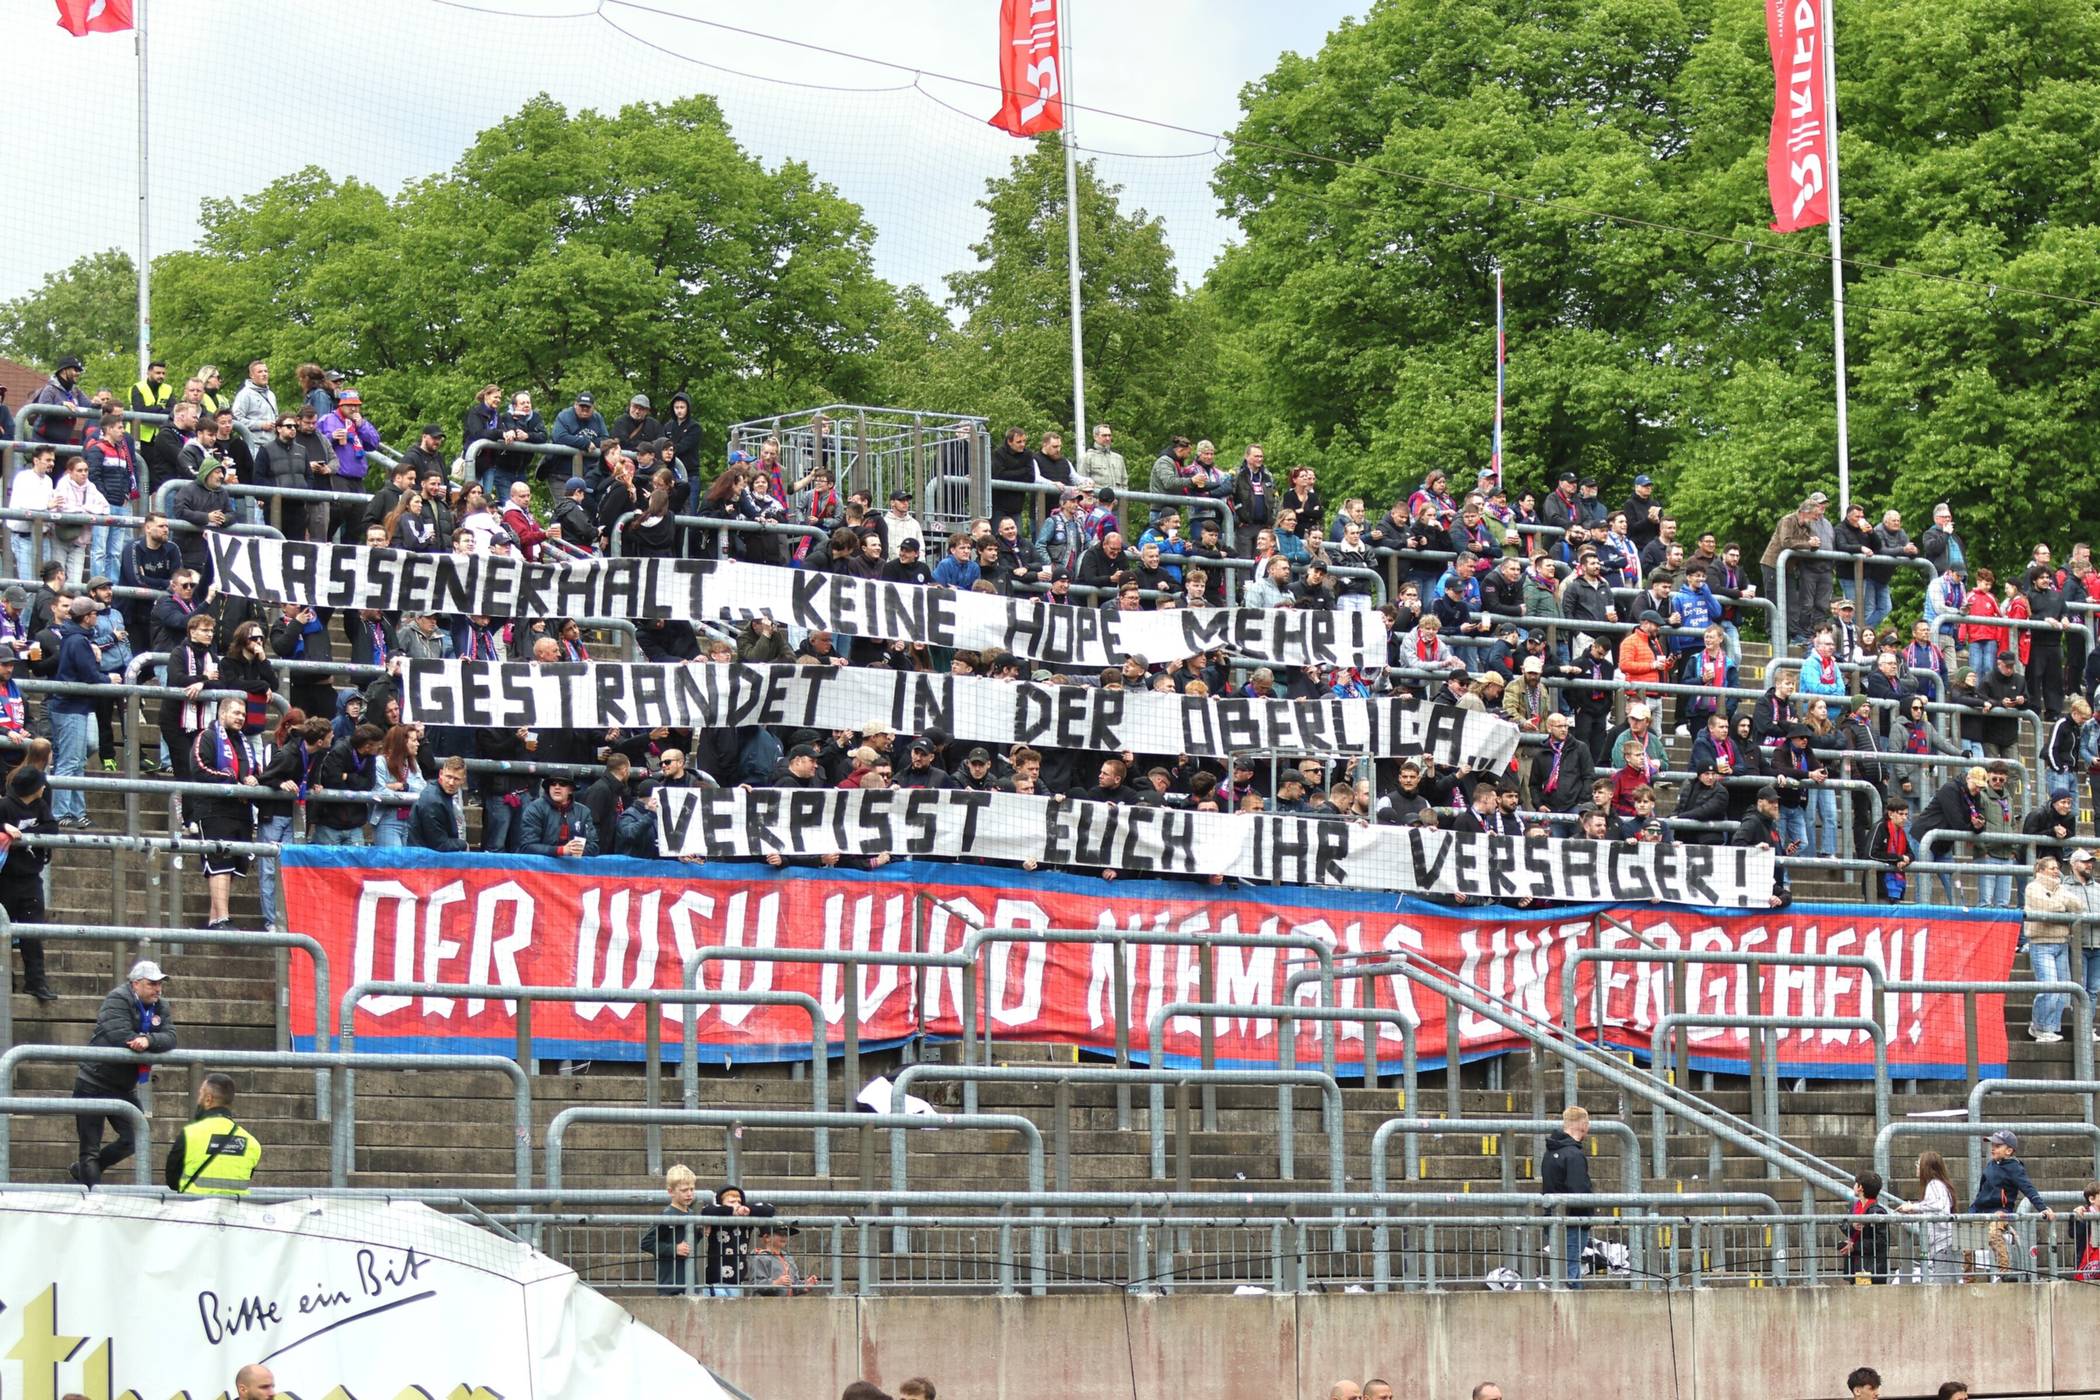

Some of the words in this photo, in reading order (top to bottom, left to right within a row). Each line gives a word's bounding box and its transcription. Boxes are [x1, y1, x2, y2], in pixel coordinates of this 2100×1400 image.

[792, 569, 956, 646] KEINE
[1003, 599, 1126, 664] HOPE
[1180, 607, 1364, 667] MEHR!
[407, 658, 838, 729] GESTRANDET
[892, 670, 954, 739] IN
[1014, 682, 1125, 750] DER
[658, 786, 990, 858] VERPISST
[1044, 799, 1196, 874] EUCH
[1253, 815, 1348, 886] IHR
[1409, 829, 1749, 905] VERSAGER!
[353, 879, 535, 1019] DER
[574, 888, 780, 1027] WSV
[1087, 908, 1423, 1042] NIEMALS
[1458, 920, 1928, 1046] UNTERGEHEN!
[198, 1290, 282, 1345] Bitte
[299, 1283, 352, 1313] ein
[357, 1246, 431, 1297] Bit
